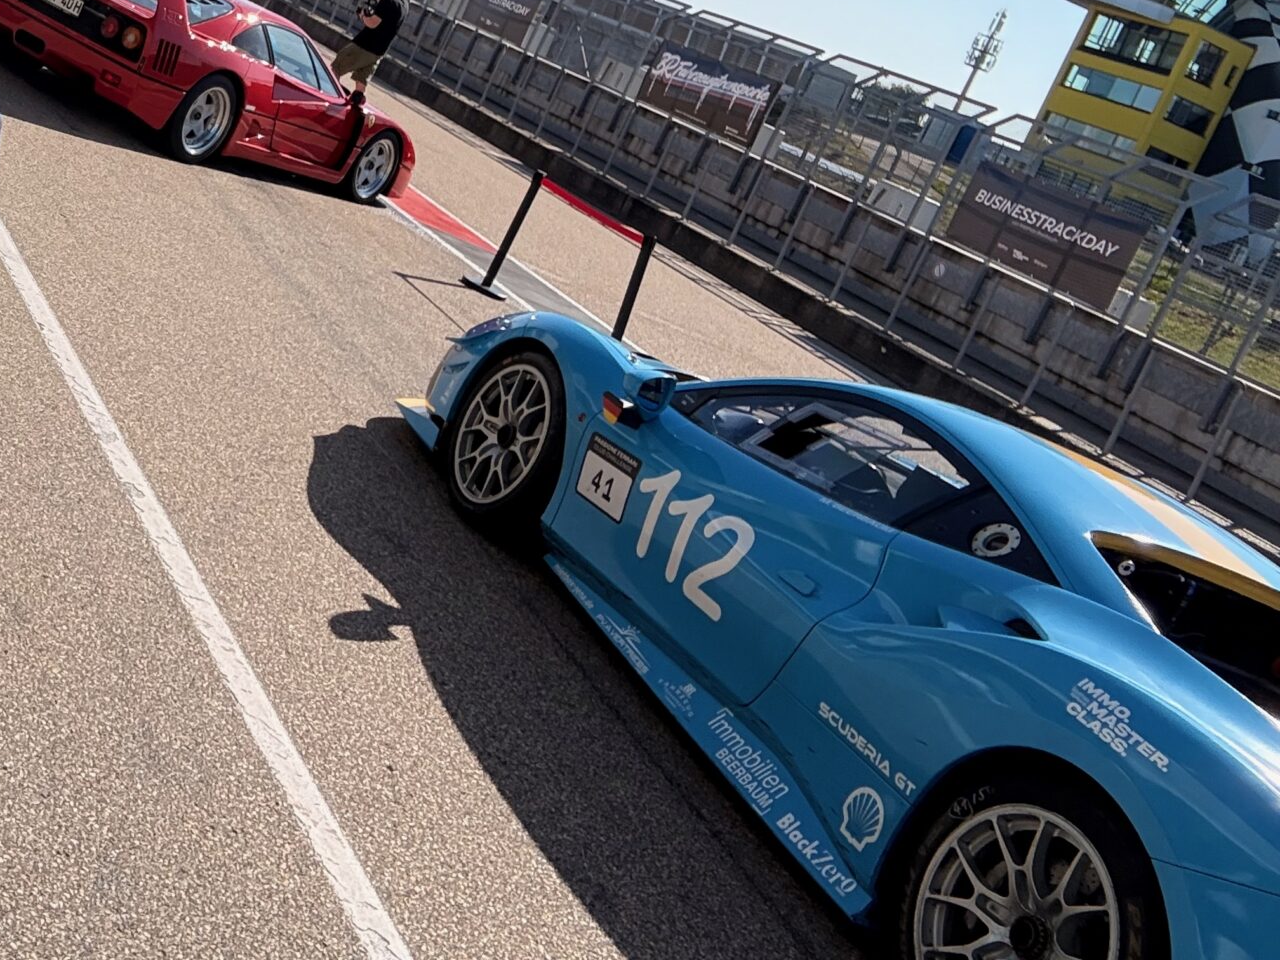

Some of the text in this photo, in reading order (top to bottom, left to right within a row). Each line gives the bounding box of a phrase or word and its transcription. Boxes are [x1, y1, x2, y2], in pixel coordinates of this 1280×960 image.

[975, 188, 1120, 258] BUSINESSTRACKDAY
[591, 469, 615, 503] 41
[636, 469, 756, 622] 112
[1066, 702, 1127, 758] CLASS.
[1077, 677, 1131, 723] IMMO.
[708, 711, 790, 799] Immobilien
[818, 701, 916, 796] SCUDERIA GT
[1086, 701, 1169, 773] MASTER.
[715, 748, 774, 809] BEERBAUM
